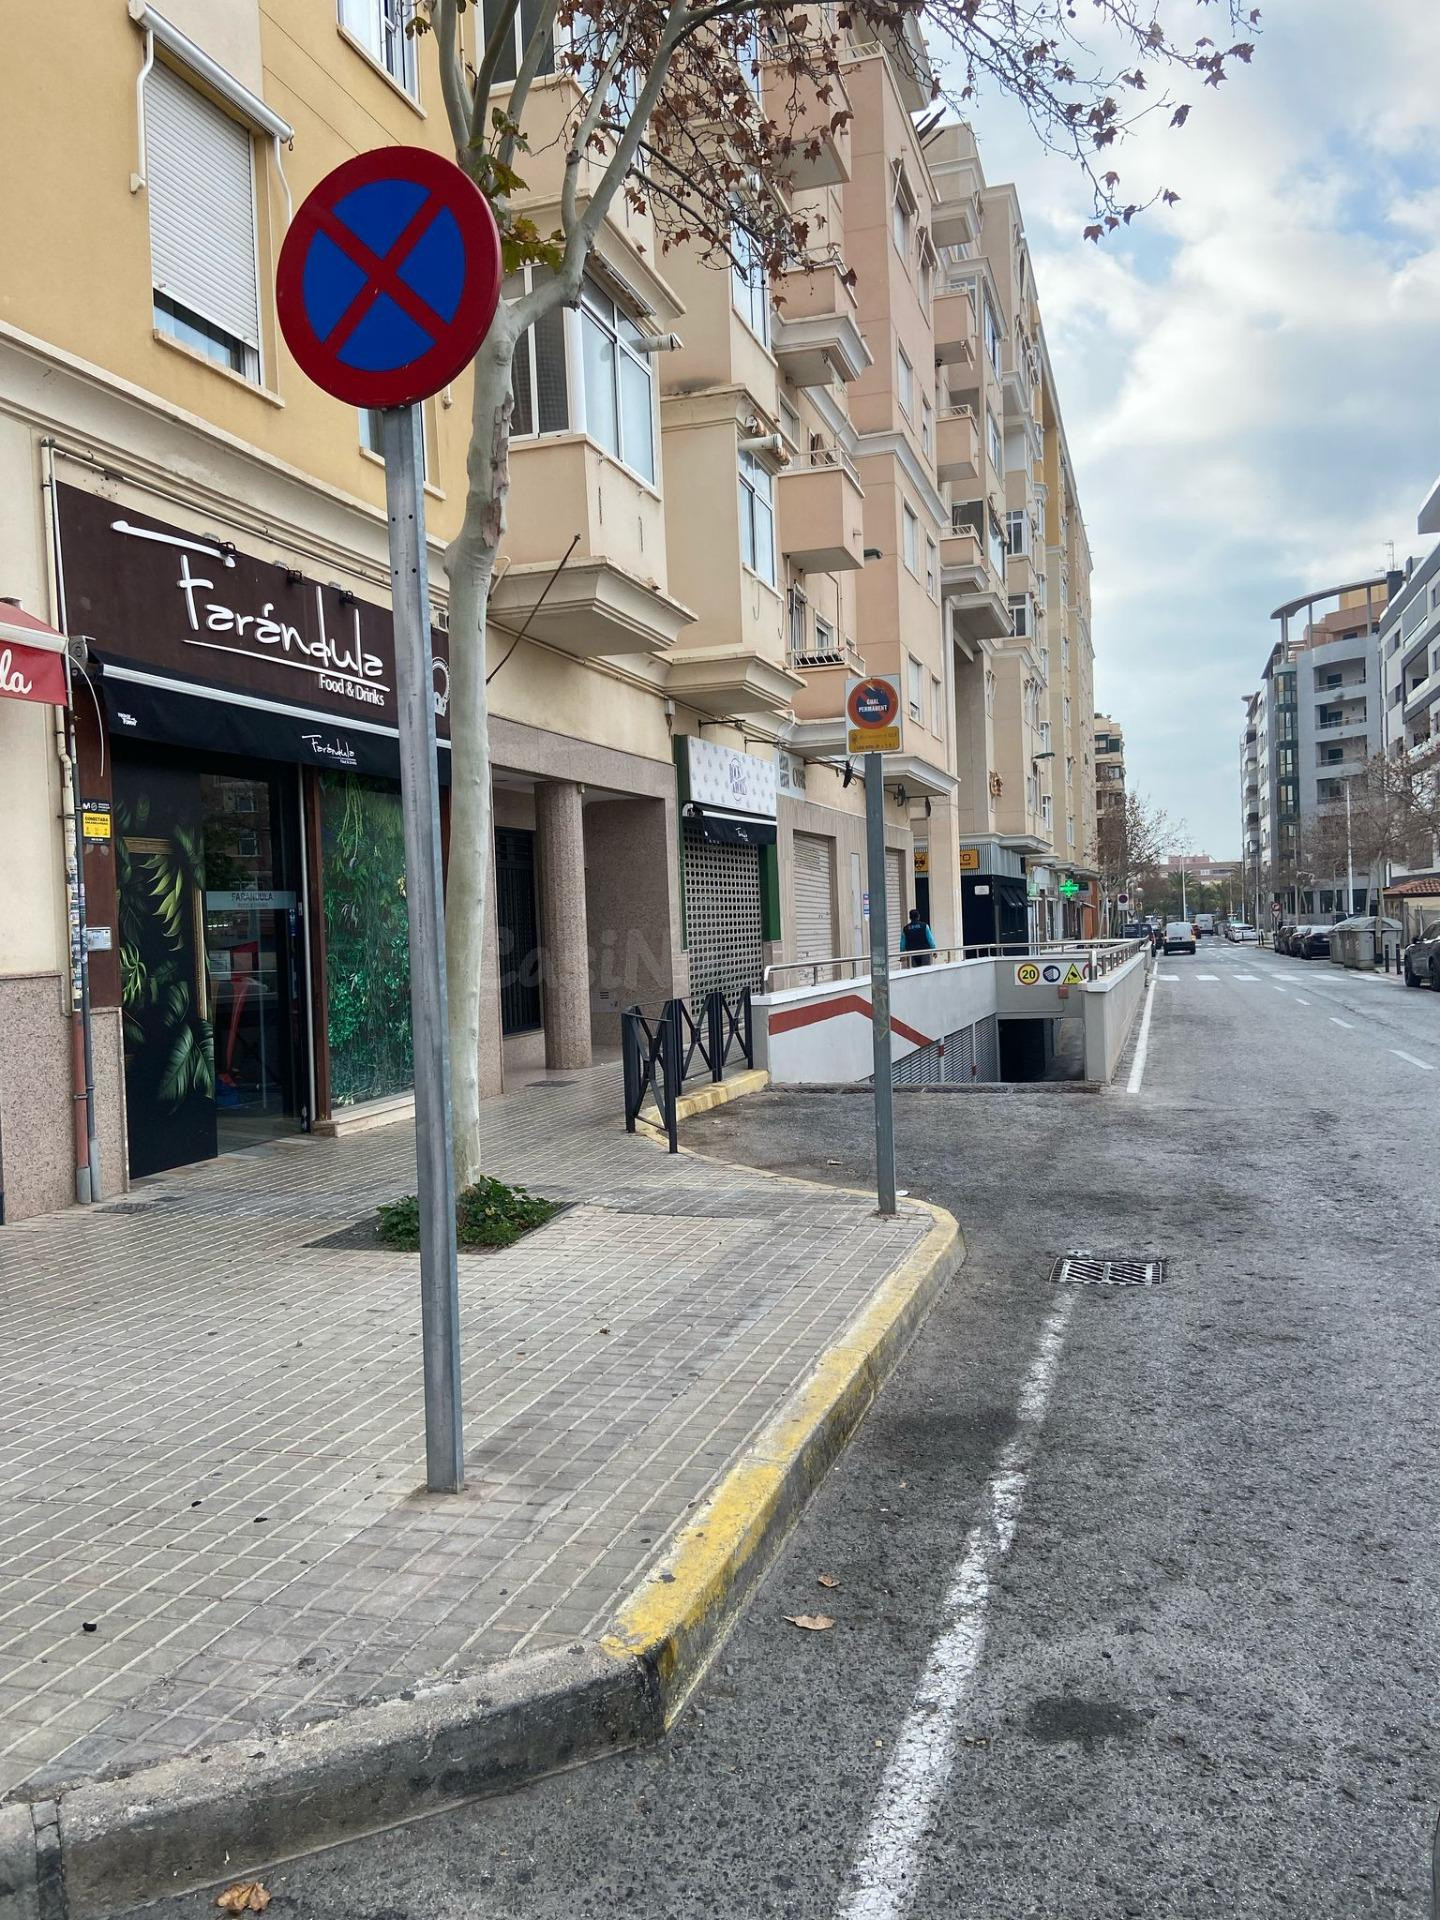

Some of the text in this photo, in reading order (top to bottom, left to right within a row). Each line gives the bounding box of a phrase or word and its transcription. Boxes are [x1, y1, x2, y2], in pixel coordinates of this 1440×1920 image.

[111, 520, 386, 678] Farándula
[319, 674, 385, 705] Food & Drinks
[1022, 969, 1036, 980] 20
